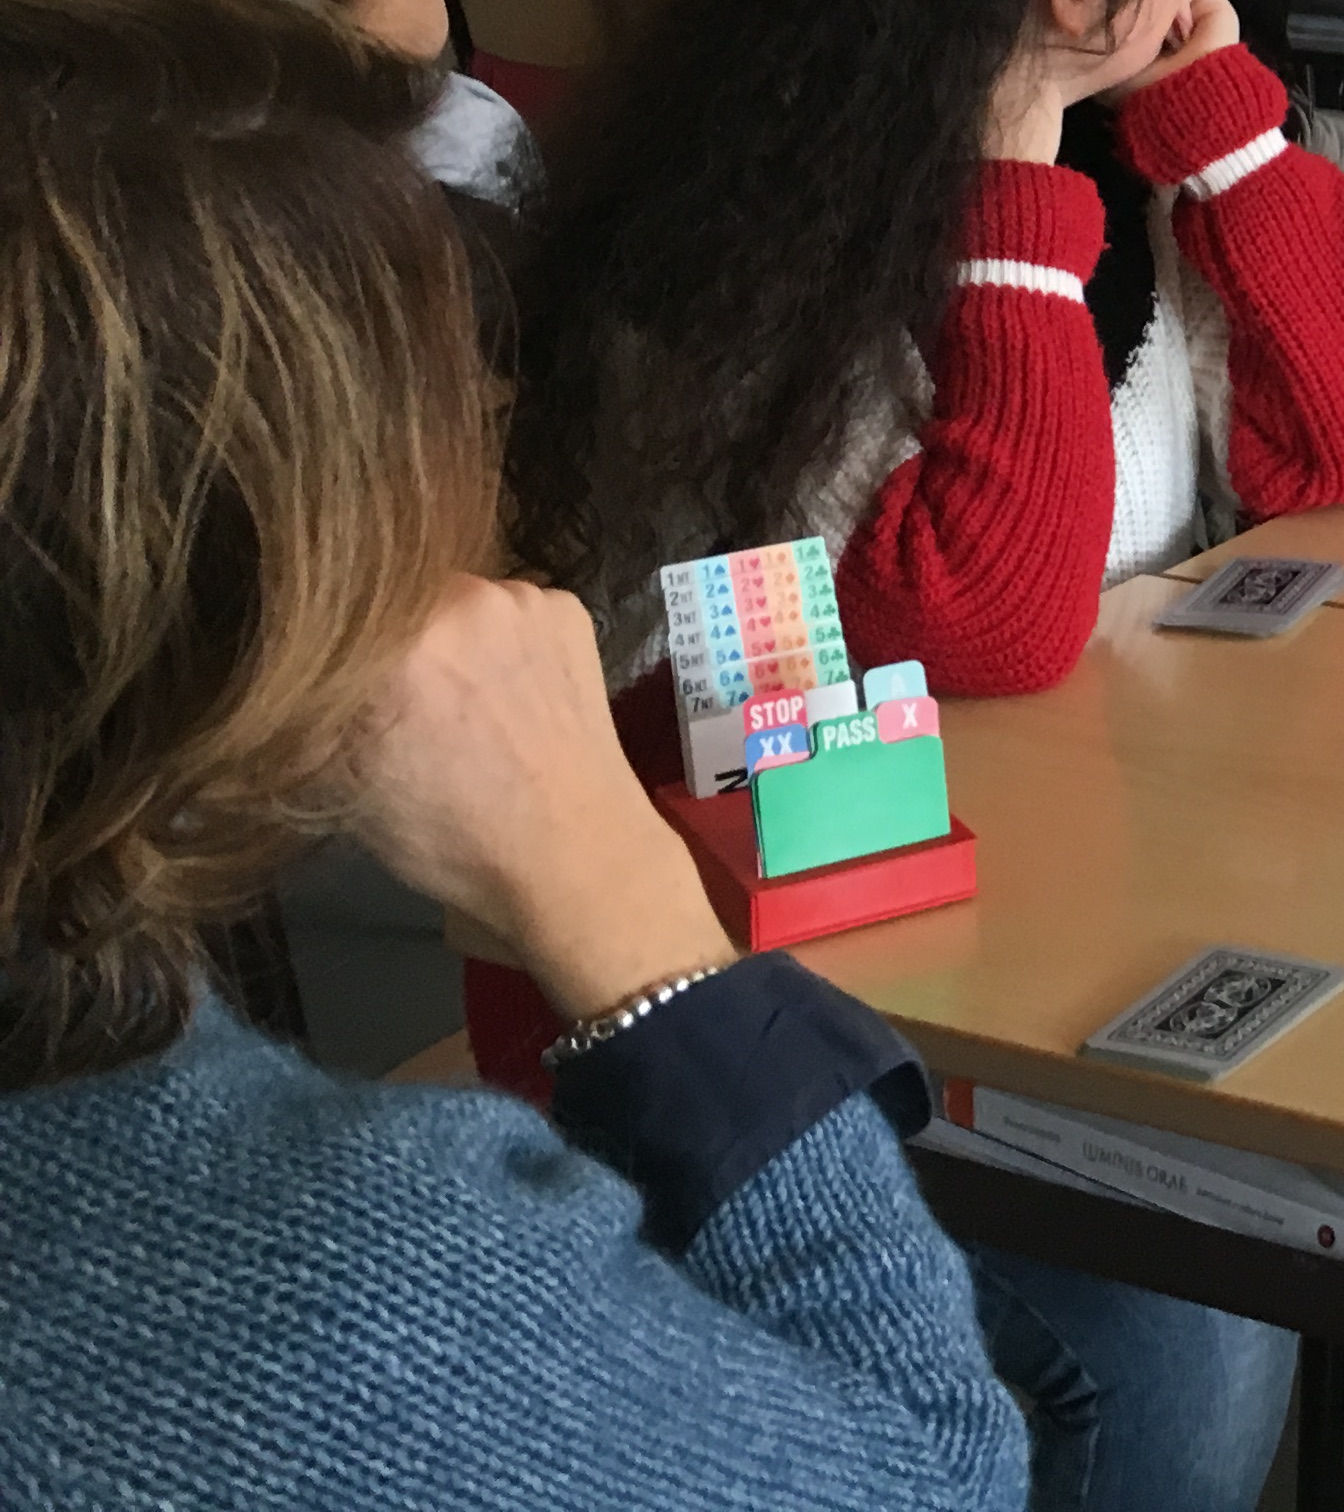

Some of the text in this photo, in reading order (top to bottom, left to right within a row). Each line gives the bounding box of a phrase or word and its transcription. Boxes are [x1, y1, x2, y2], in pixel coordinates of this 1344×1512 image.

[819, 649, 829, 665] 6
[750, 695, 803, 730] STOP
[901, 702, 919, 730] X
[822, 716, 876, 751] PASS
[1082, 1141, 1143, 1179] LUMINIS
